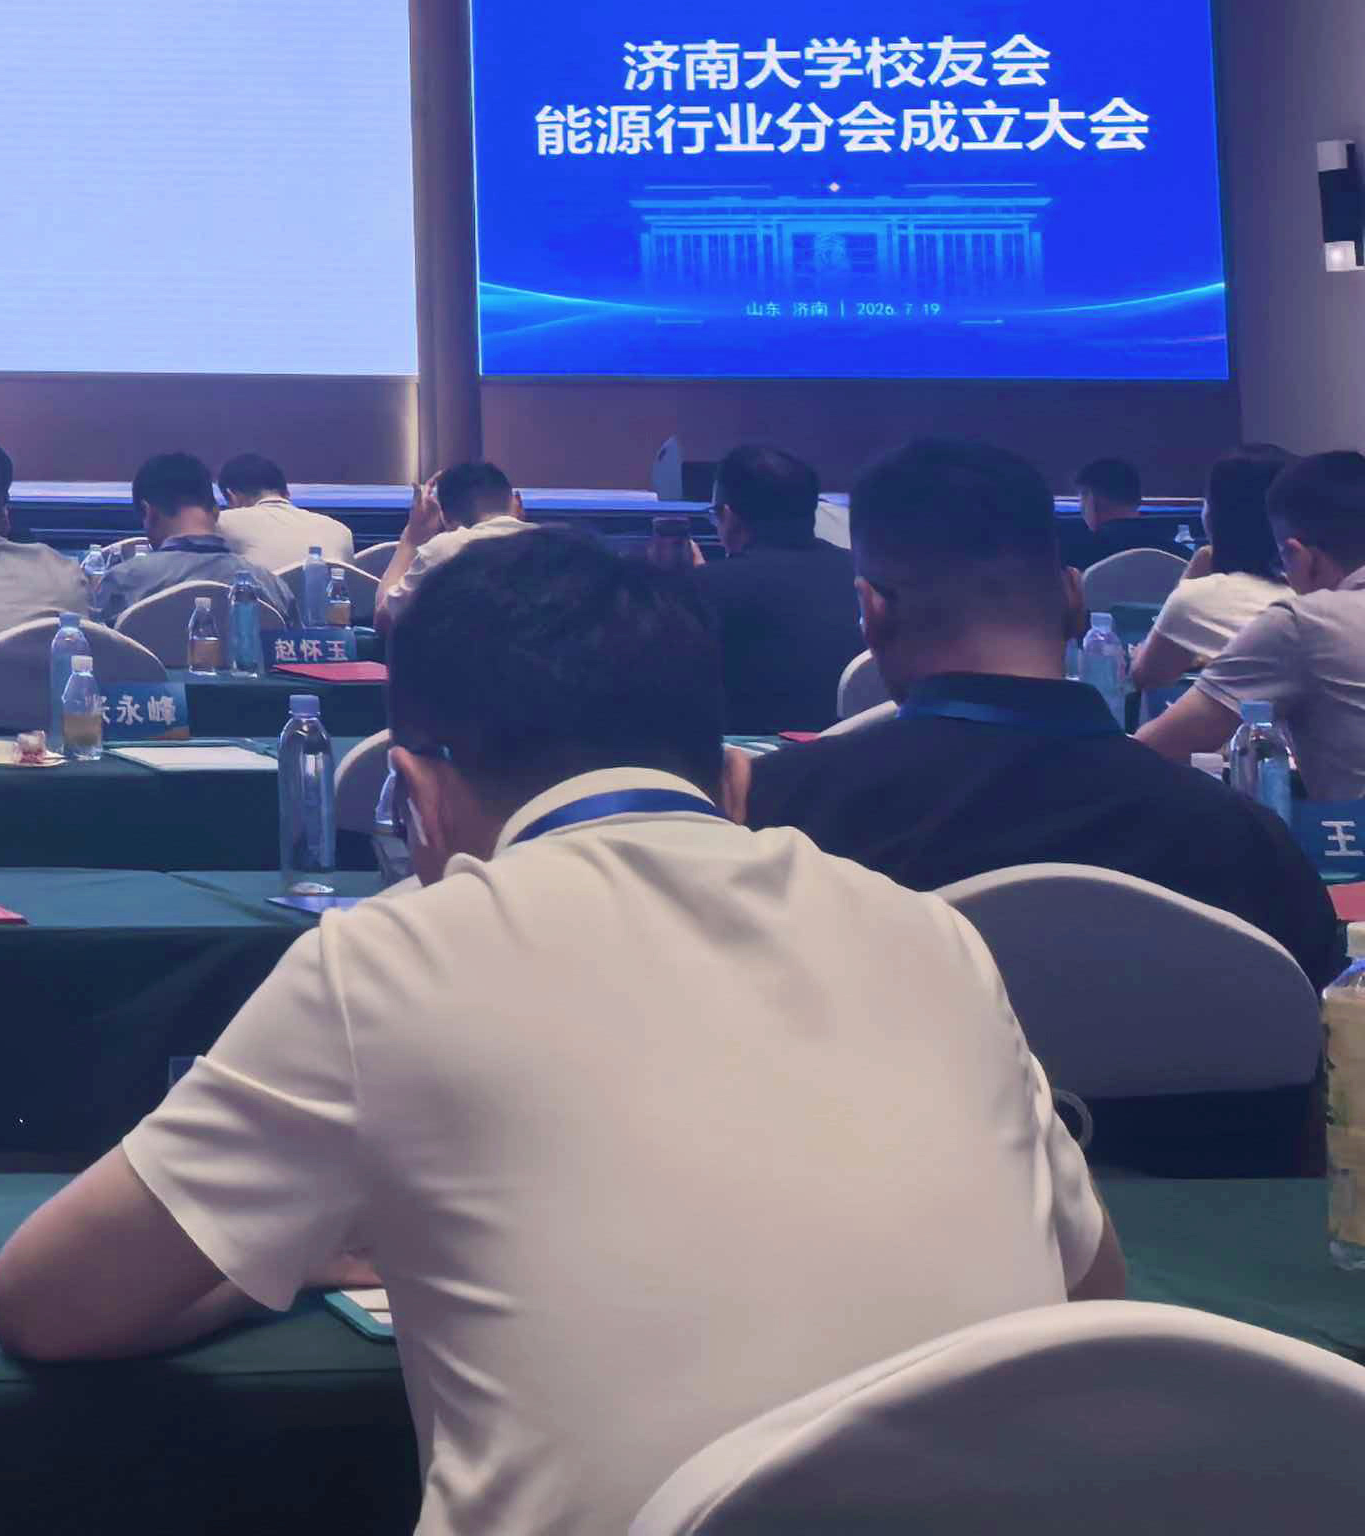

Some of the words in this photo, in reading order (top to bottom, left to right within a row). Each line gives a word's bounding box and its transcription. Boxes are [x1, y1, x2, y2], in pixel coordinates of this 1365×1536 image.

[623, 34, 1051, 91] 济南大学校友会
[535, 97, 1149, 156] 能源行业分会成立大会
[747, 302, 781, 317] 山东
[275, 638, 349, 662] 赵怀玉
